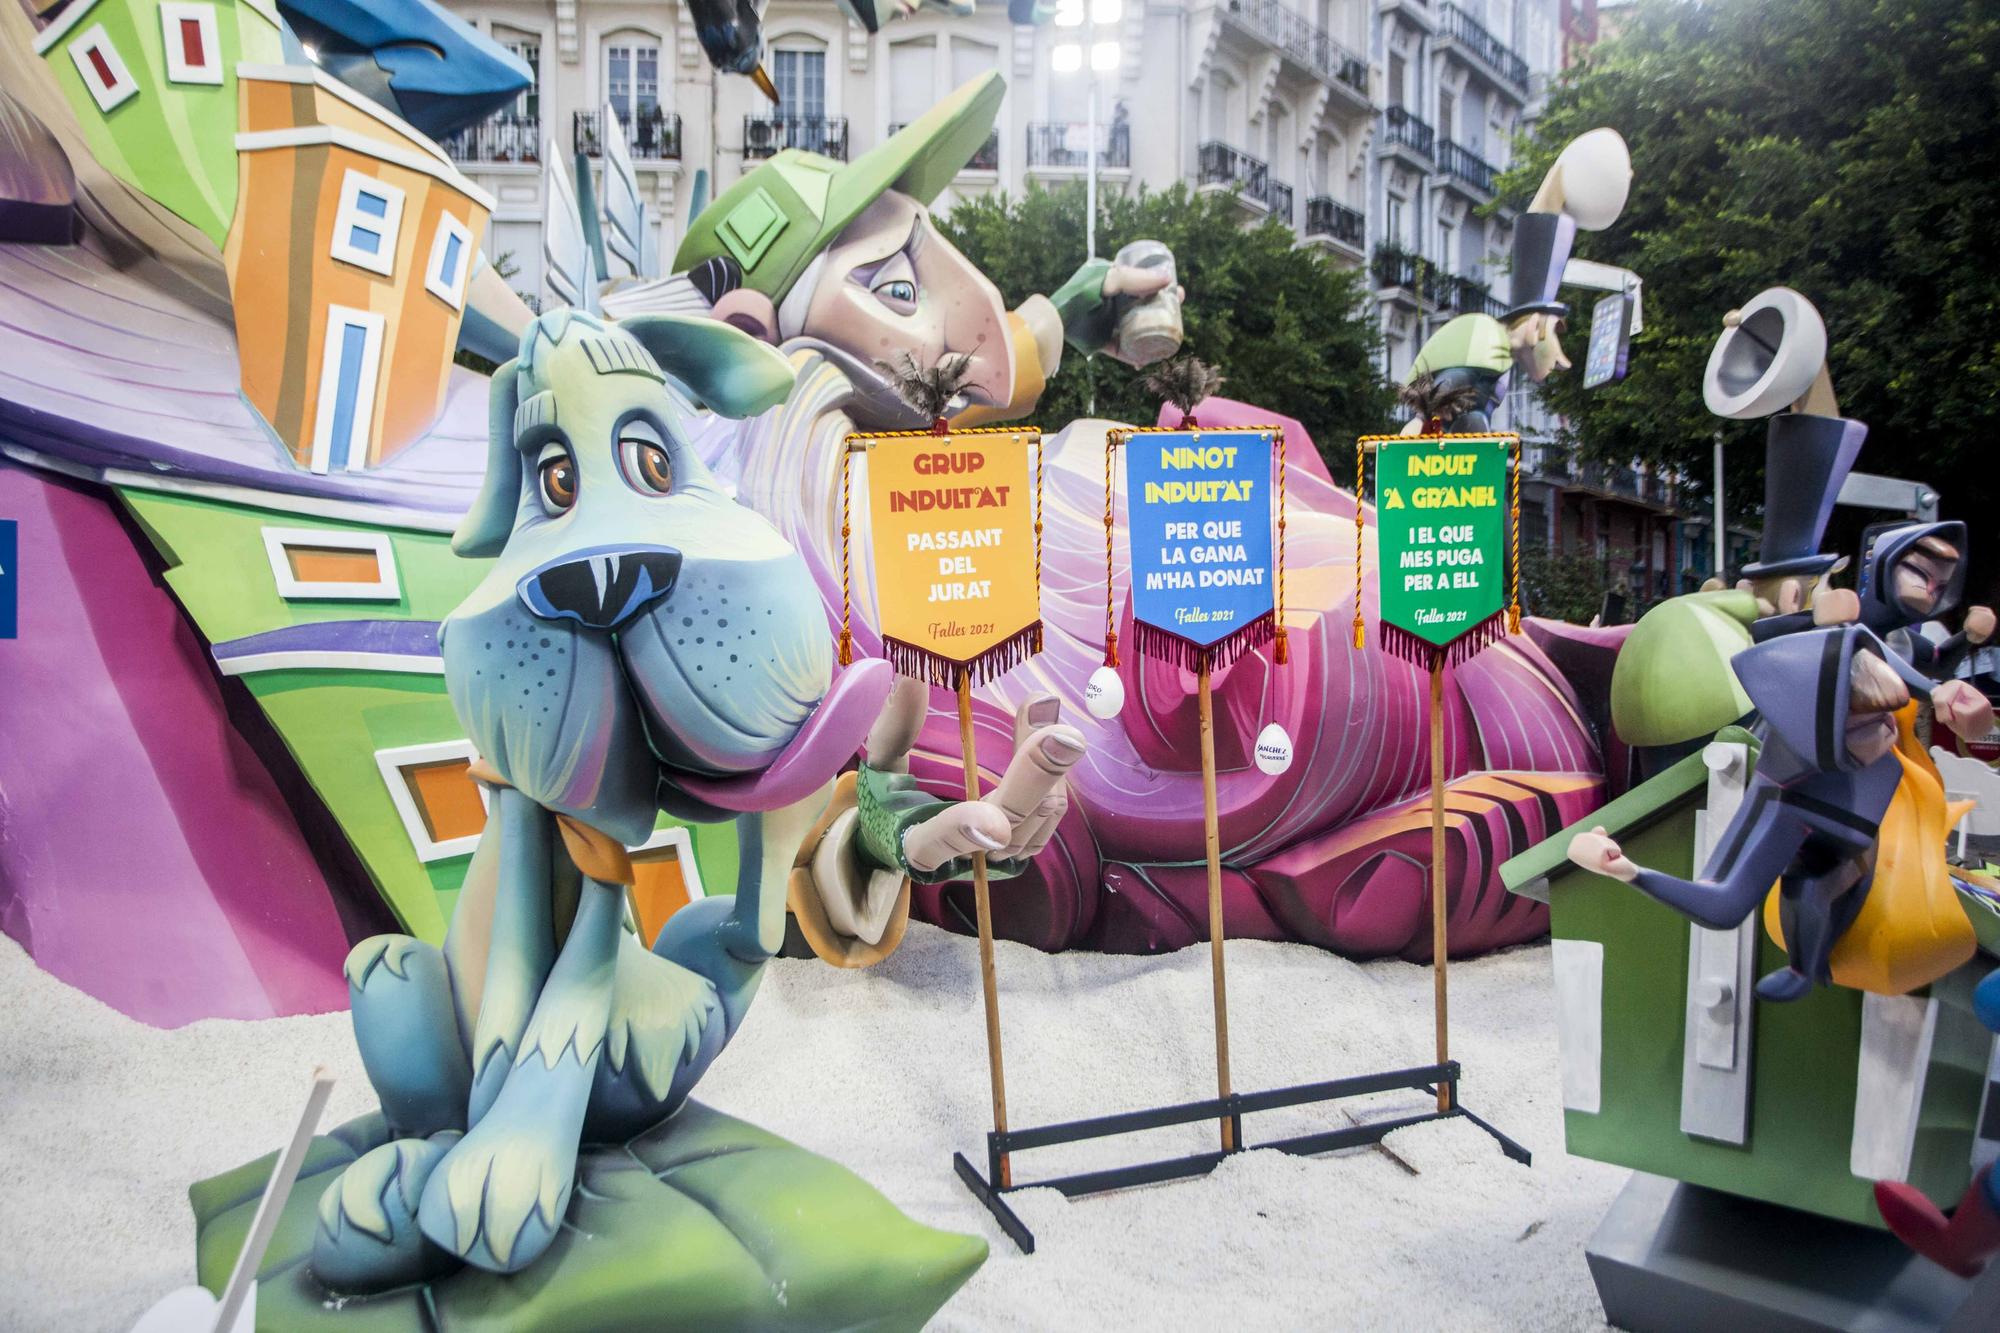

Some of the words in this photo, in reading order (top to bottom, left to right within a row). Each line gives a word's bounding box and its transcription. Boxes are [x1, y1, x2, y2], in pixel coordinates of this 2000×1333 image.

[914, 452, 984, 475] GRUP
[1161, 447, 1237, 470] NINOT
[1408, 455, 1477, 477] INDULT
[1412, 486, 1496, 509] GRANEL
[908, 529, 1002, 551] PASSANT
[1165, 523, 1198, 540] PER
[1203, 521, 1241, 540] QUE
[1409, 528, 1414, 544] I
[1419, 527, 1435, 544] EL
[1439, 526, 1473, 544] QUE
[1161, 547, 1186, 565] LA
[1190, 545, 1247, 564] GANA
[1400, 551, 1433, 568] MES
[1437, 548, 1483, 566] PUGA
[939, 557, 976, 575] DEL
[1146, 572, 1195, 590] M'HA
[1200, 568, 1264, 587] DONAT
[1405, 574, 1433, 591] PER
[1437, 573, 1449, 590] A
[1454, 572, 1479, 589] ELL
[928, 581, 991, 602] JURAT
[1175, 607, 1209, 624] Falles
[1212, 610, 1234, 621] 2021
[1415, 608, 1444, 625] Falles
[1446, 610, 1467, 622] 2021
[928, 622, 965, 640] Falles
[970, 623, 994, 635] 2021
